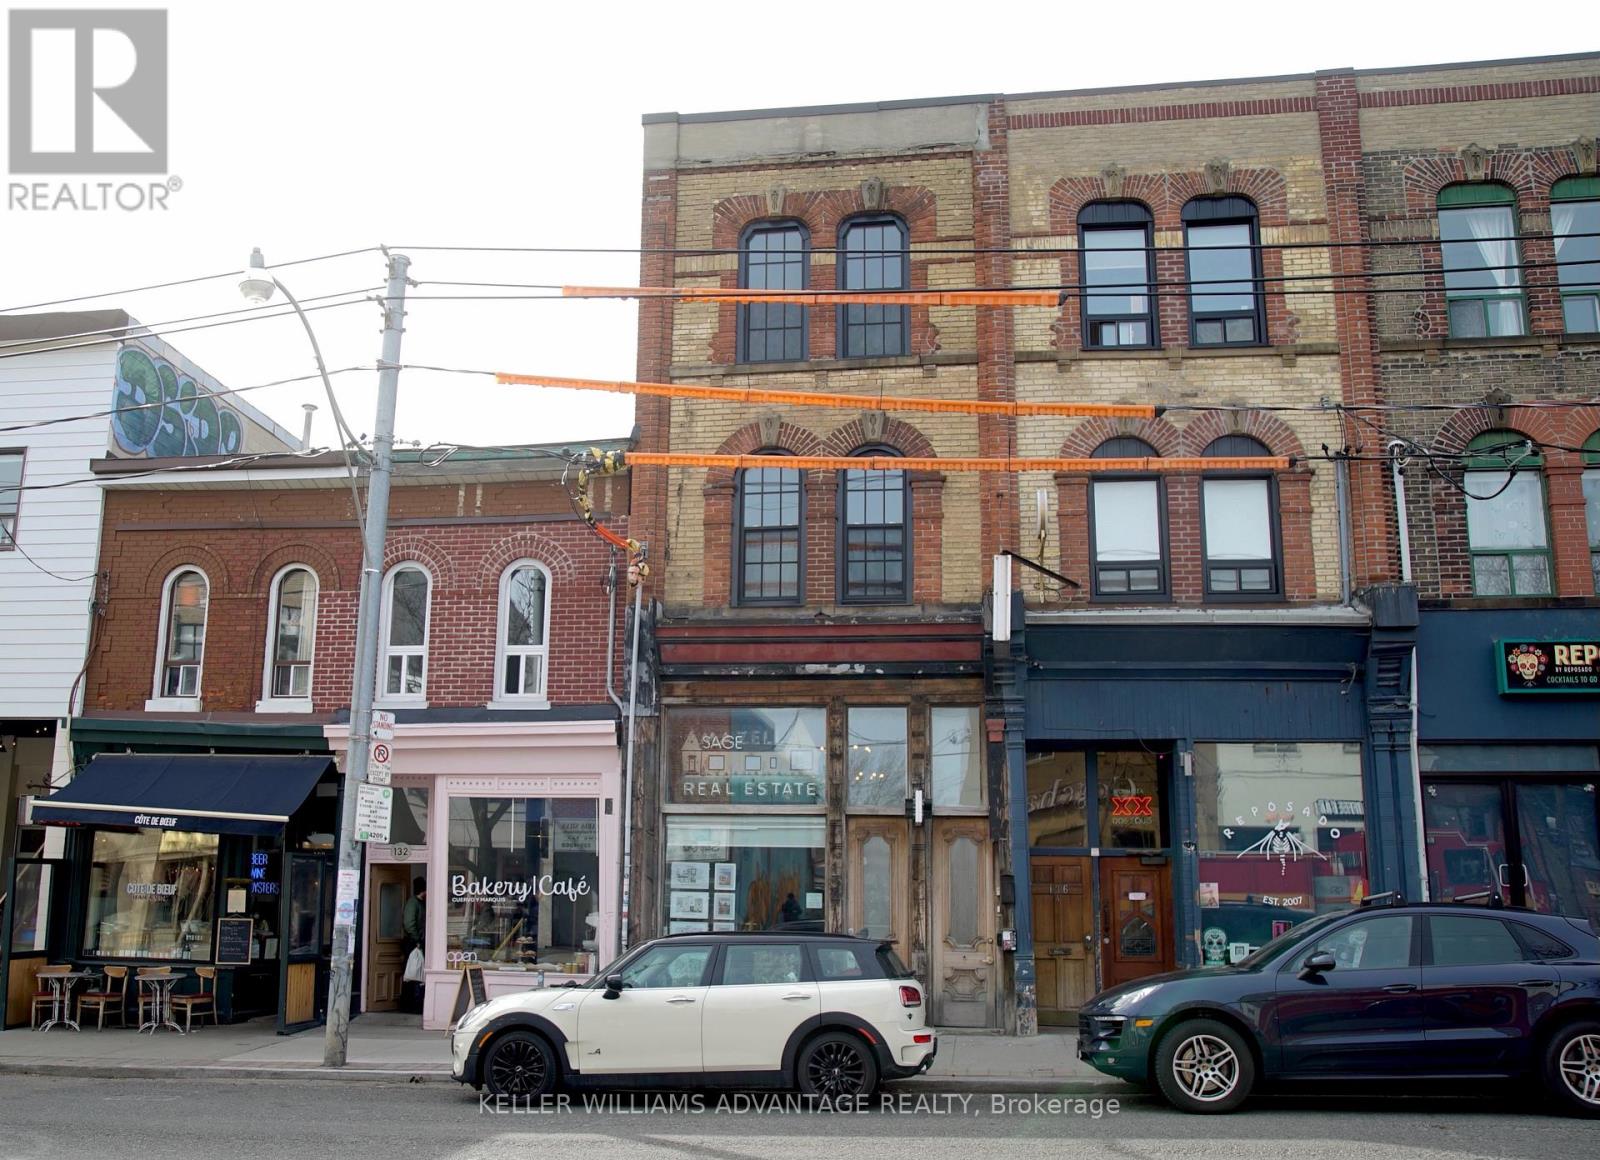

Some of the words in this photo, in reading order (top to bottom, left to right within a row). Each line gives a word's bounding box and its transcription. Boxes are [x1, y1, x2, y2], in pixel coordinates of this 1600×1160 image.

[1554, 644, 1600, 665] REP
[1546, 675, 1579, 684] COCKTAILS
[1580, 676, 1588, 684] TO
[1589, 676, 1598, 684] GO
[702, 735, 743, 750] SAGE
[683, 782, 735, 796] REAL
[744, 782, 817, 796] ESTATE
[1111, 796, 1153, 816] XX
[134, 813, 151, 825] CÔTE
[151, 816, 160, 826] DE
[394, 847, 409, 856] 132
[1262, 896, 1280, 907] EST.
[1282, 896, 1303, 907] 2007
[447, 952, 478, 969] open
